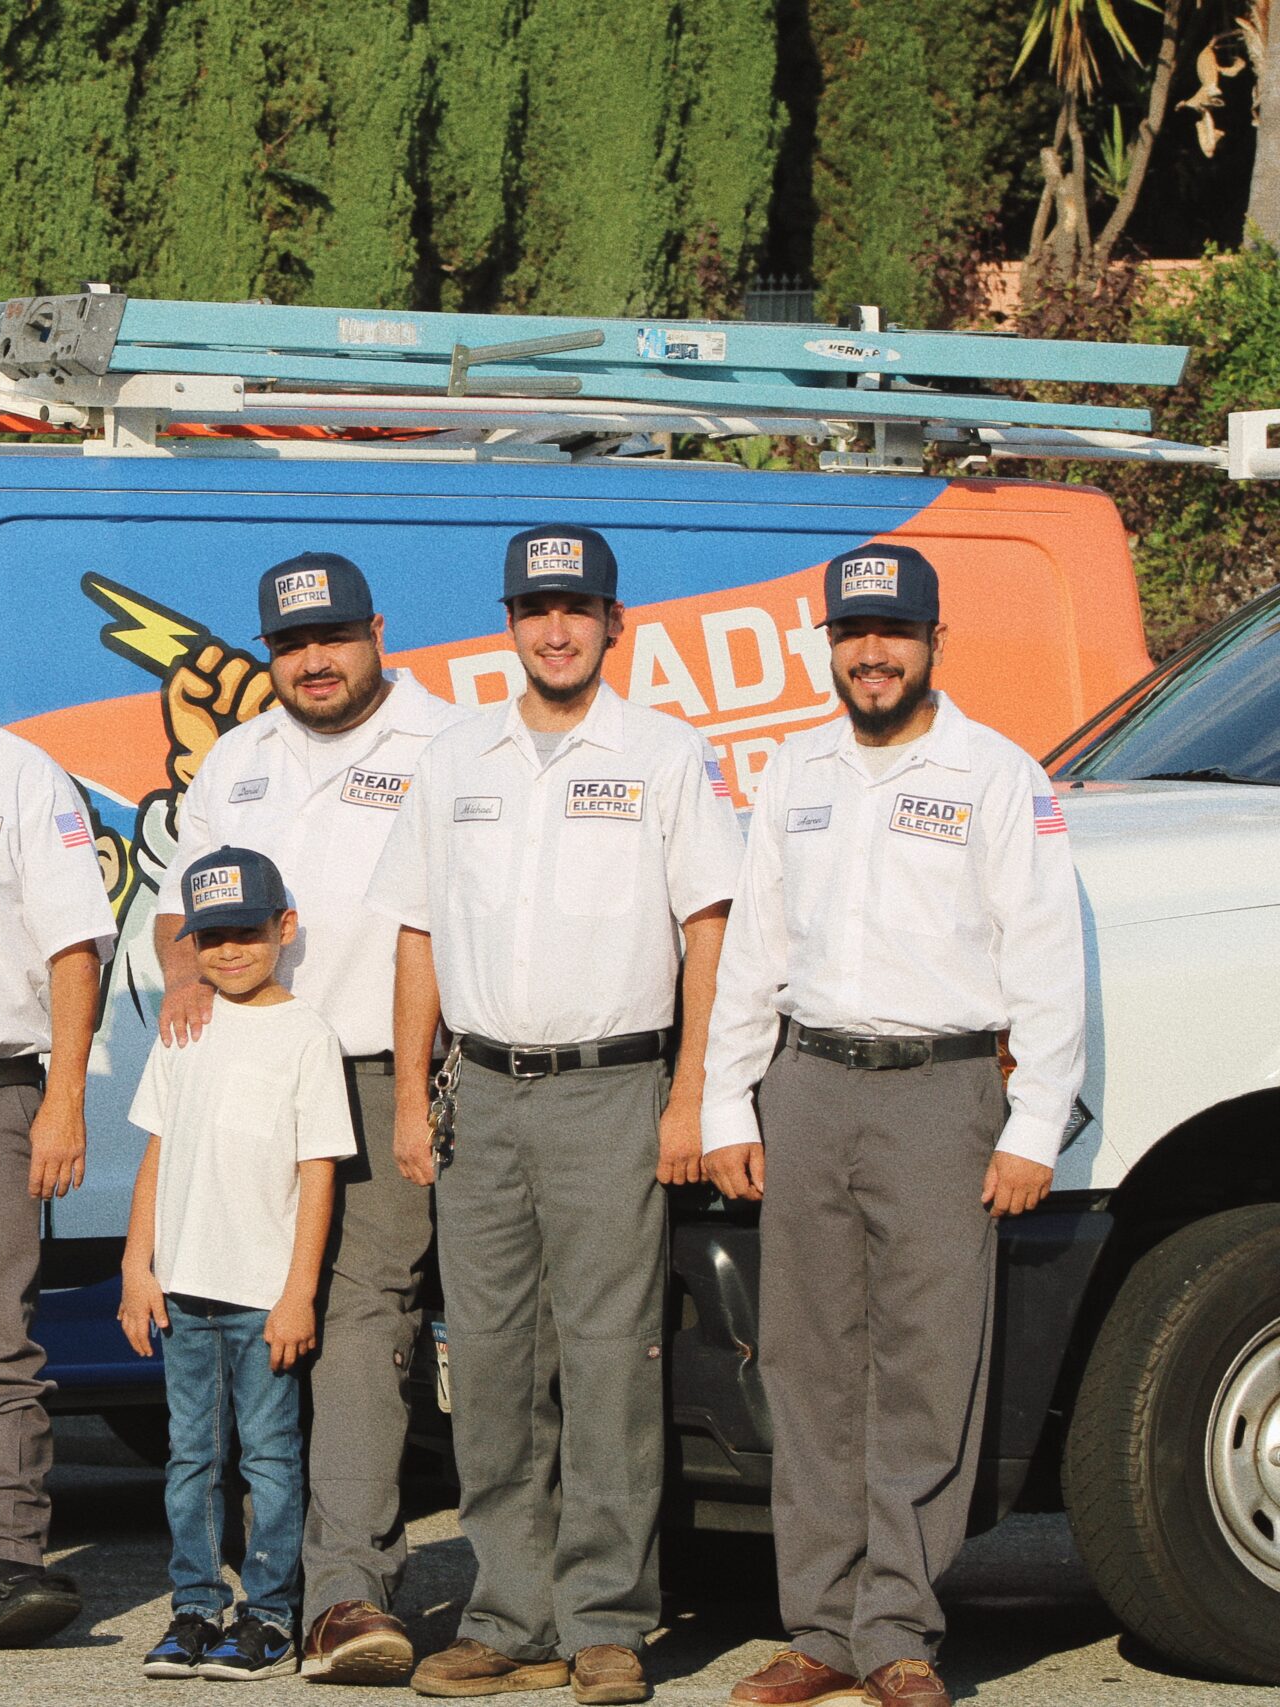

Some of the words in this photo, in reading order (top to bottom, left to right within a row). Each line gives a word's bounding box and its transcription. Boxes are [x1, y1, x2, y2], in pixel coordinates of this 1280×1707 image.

[530, 541, 571, 558] READ
[531, 559, 580, 571] ELECTRIC
[844, 561, 885, 579] READ
[278, 573, 316, 595] READ
[844, 579, 894, 593] ELECTRIC
[281, 590, 327, 608] ELECTRIC
[351, 771, 401, 791] READ
[573, 783, 627, 798] READ
[461, 803, 494, 814] Michael
[573, 800, 637, 813] ELECTRIC
[900, 798, 956, 821] READ
[898, 816, 963, 837] ELECTRIC
[192, 870, 229, 892] READ
[195, 887, 239, 904] ELECTRIC
